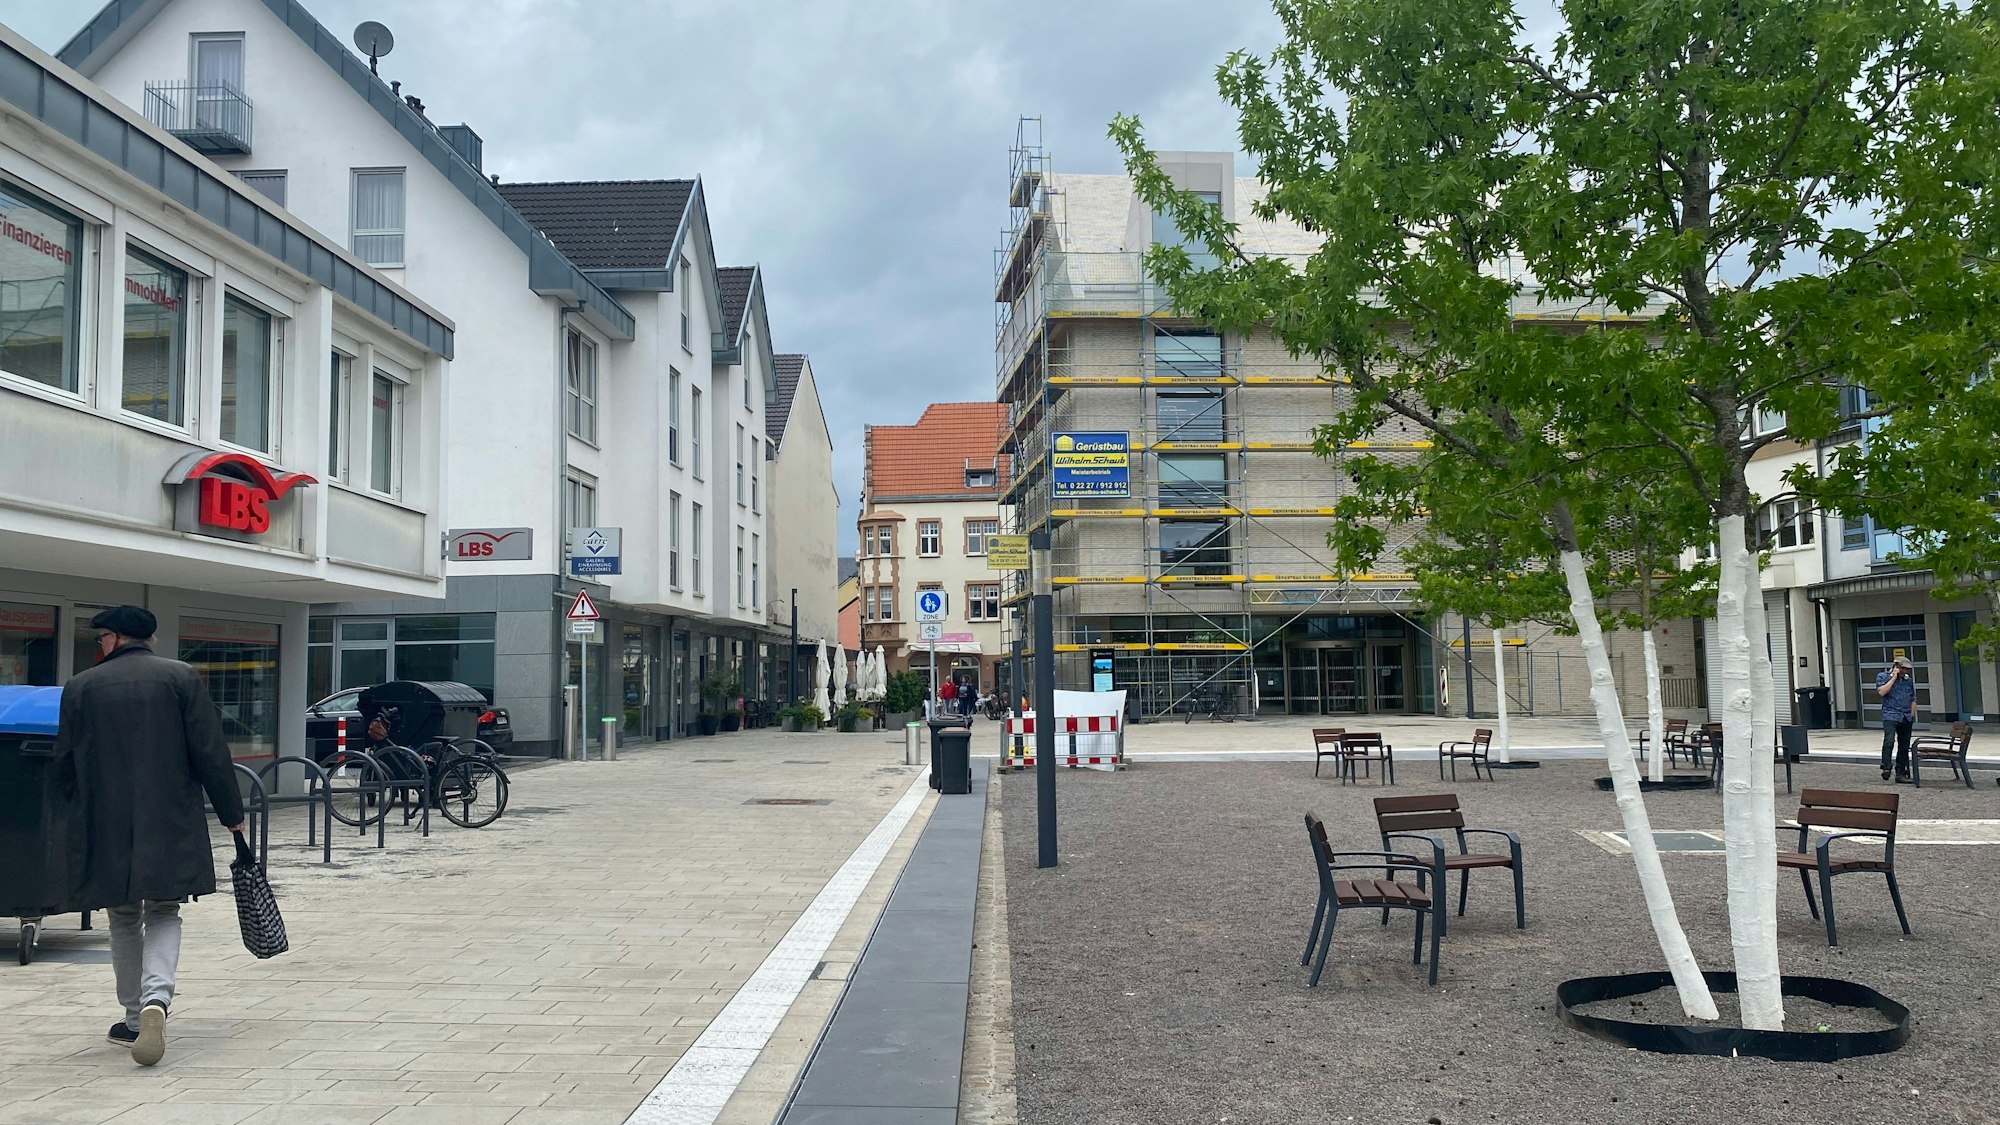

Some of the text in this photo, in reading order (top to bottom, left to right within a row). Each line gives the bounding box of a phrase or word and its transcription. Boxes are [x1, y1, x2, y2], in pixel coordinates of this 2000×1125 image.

[1076, 442, 1124, 451] Gerüstbau
[1056, 456, 1126, 464] Wilhelm Schaub
[202, 478, 270, 533] LBS
[458, 541, 494, 557] LBS
